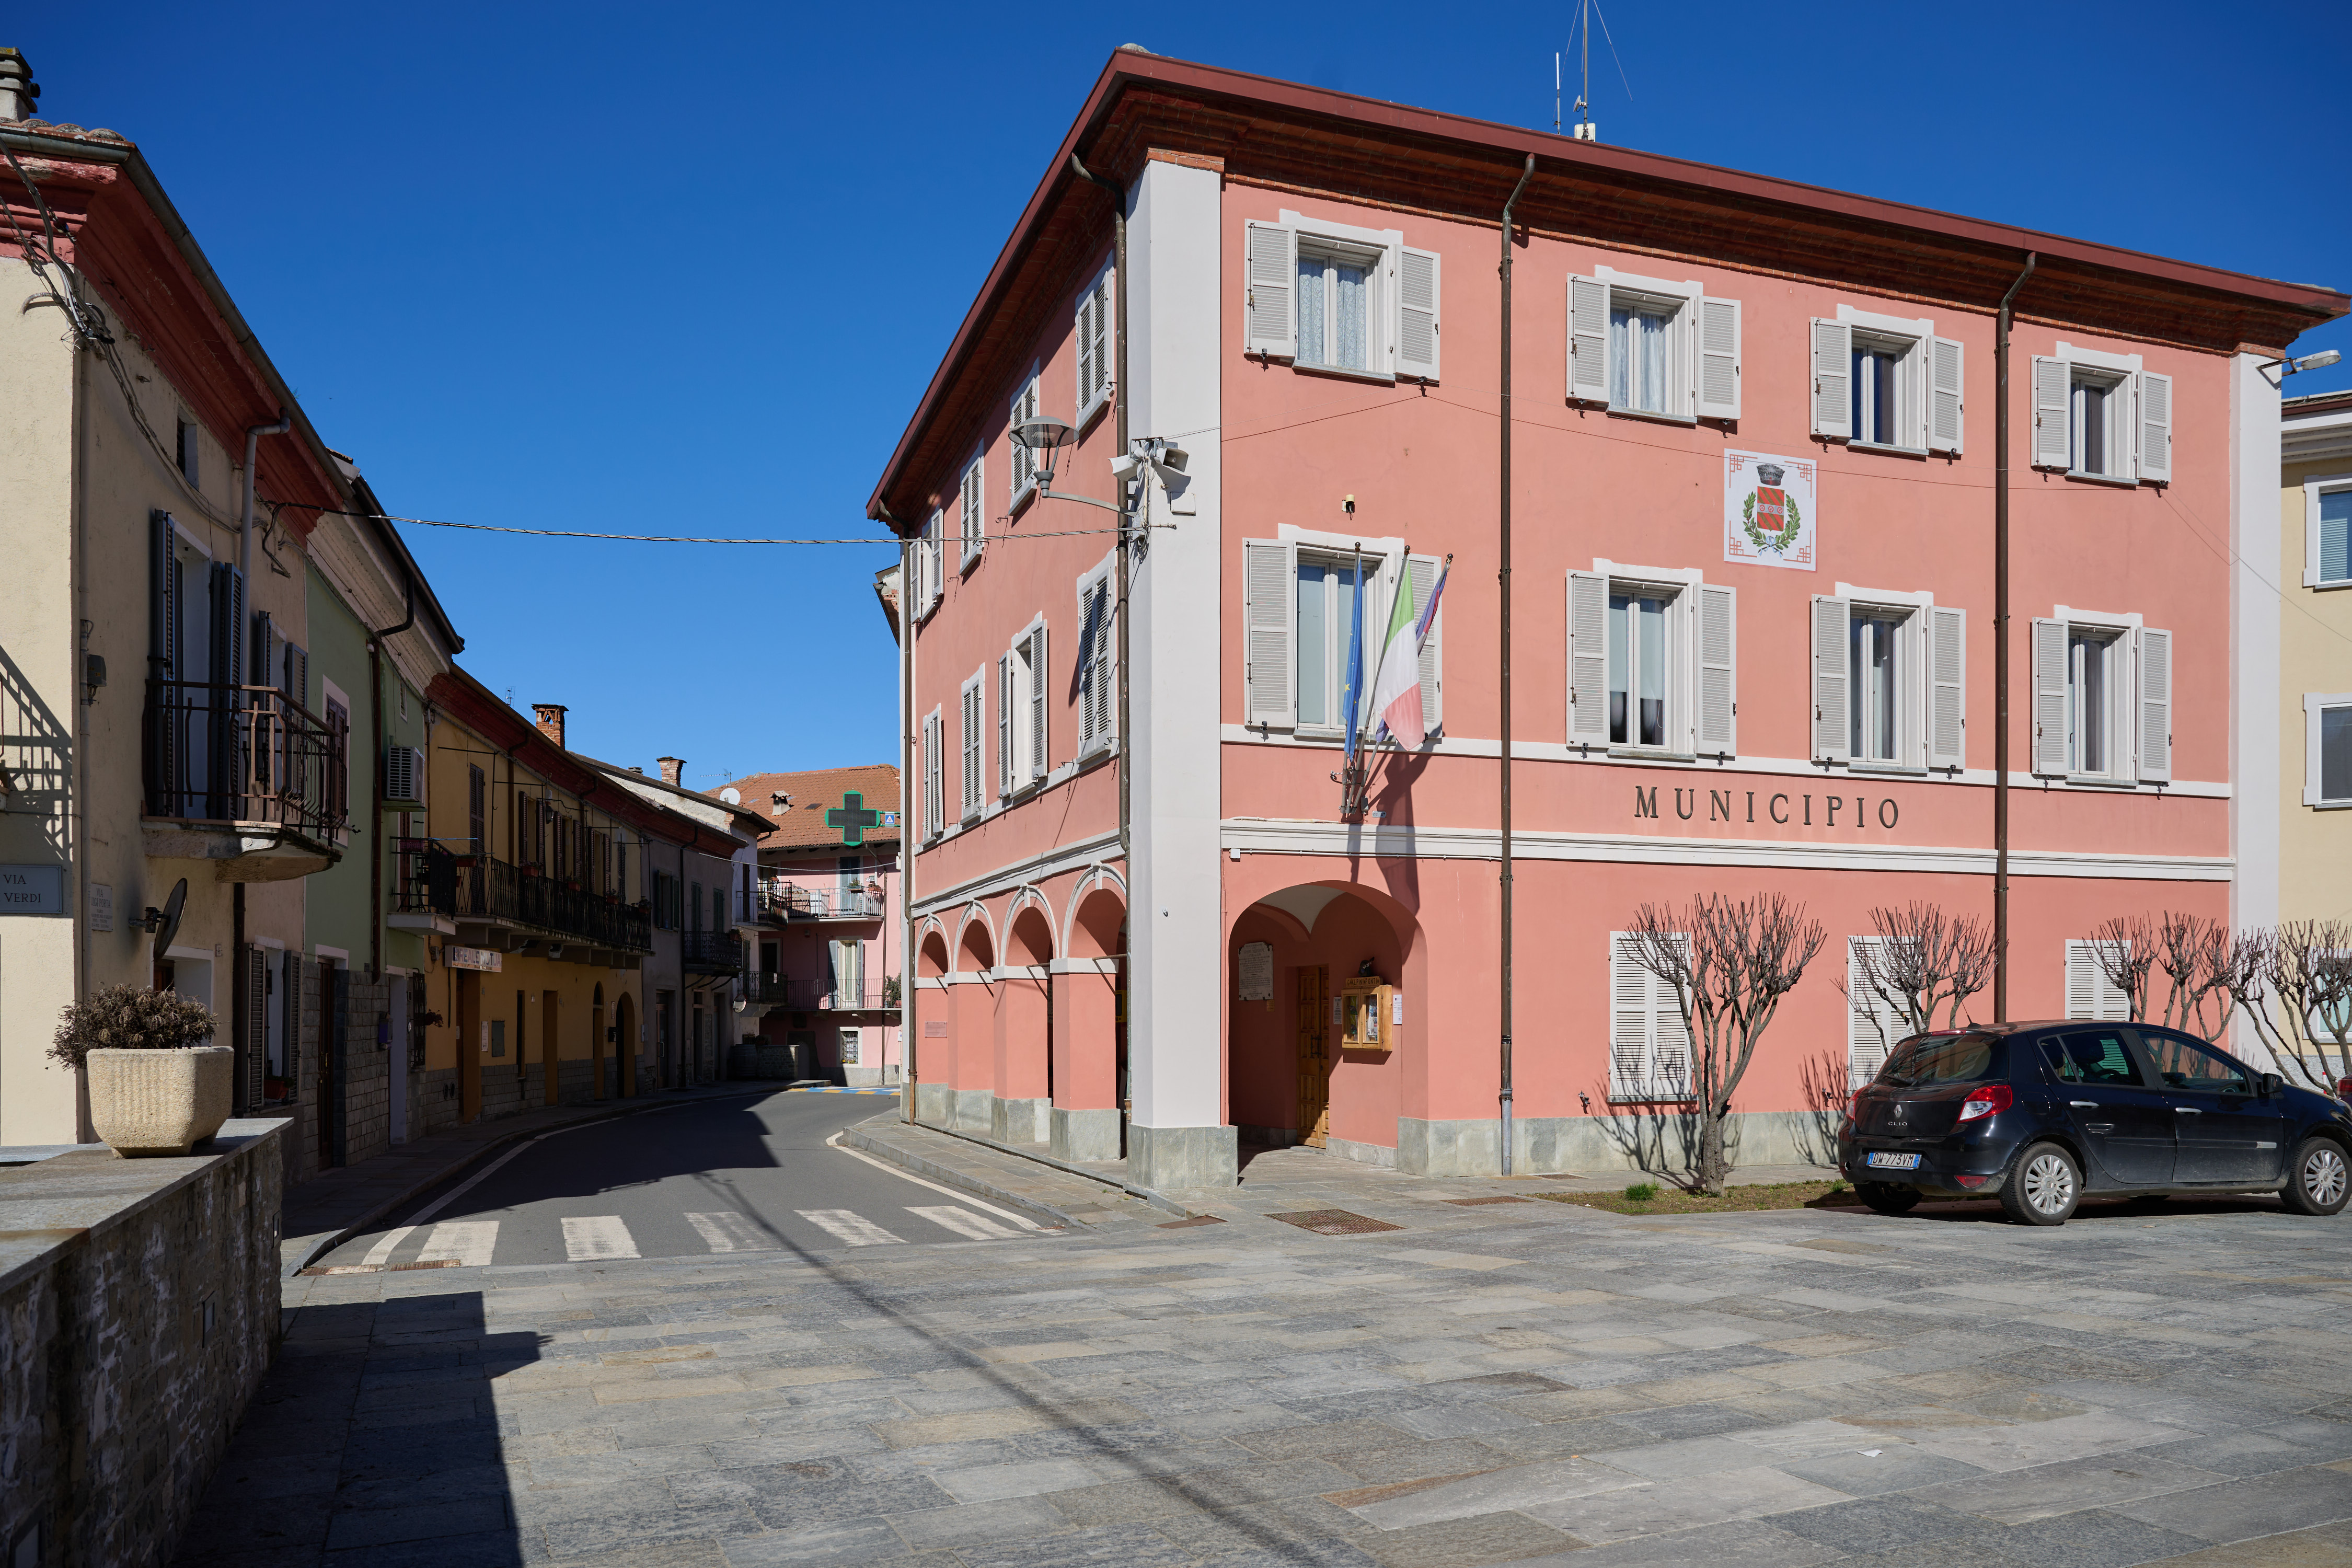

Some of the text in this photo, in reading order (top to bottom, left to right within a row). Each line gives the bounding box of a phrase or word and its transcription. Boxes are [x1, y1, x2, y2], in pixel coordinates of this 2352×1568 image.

[1634, 785, 1899, 829] MUNICIPIO
[3, 874, 27, 884] VIA
[4, 893, 42, 903] VERDI
[99, 898, 111, 908] PORTA
[459, 948, 501, 966] REALE MUTUA
[1873, 1153, 1884, 1164] DW
[1886, 1153, 1915, 1167] 773VM
